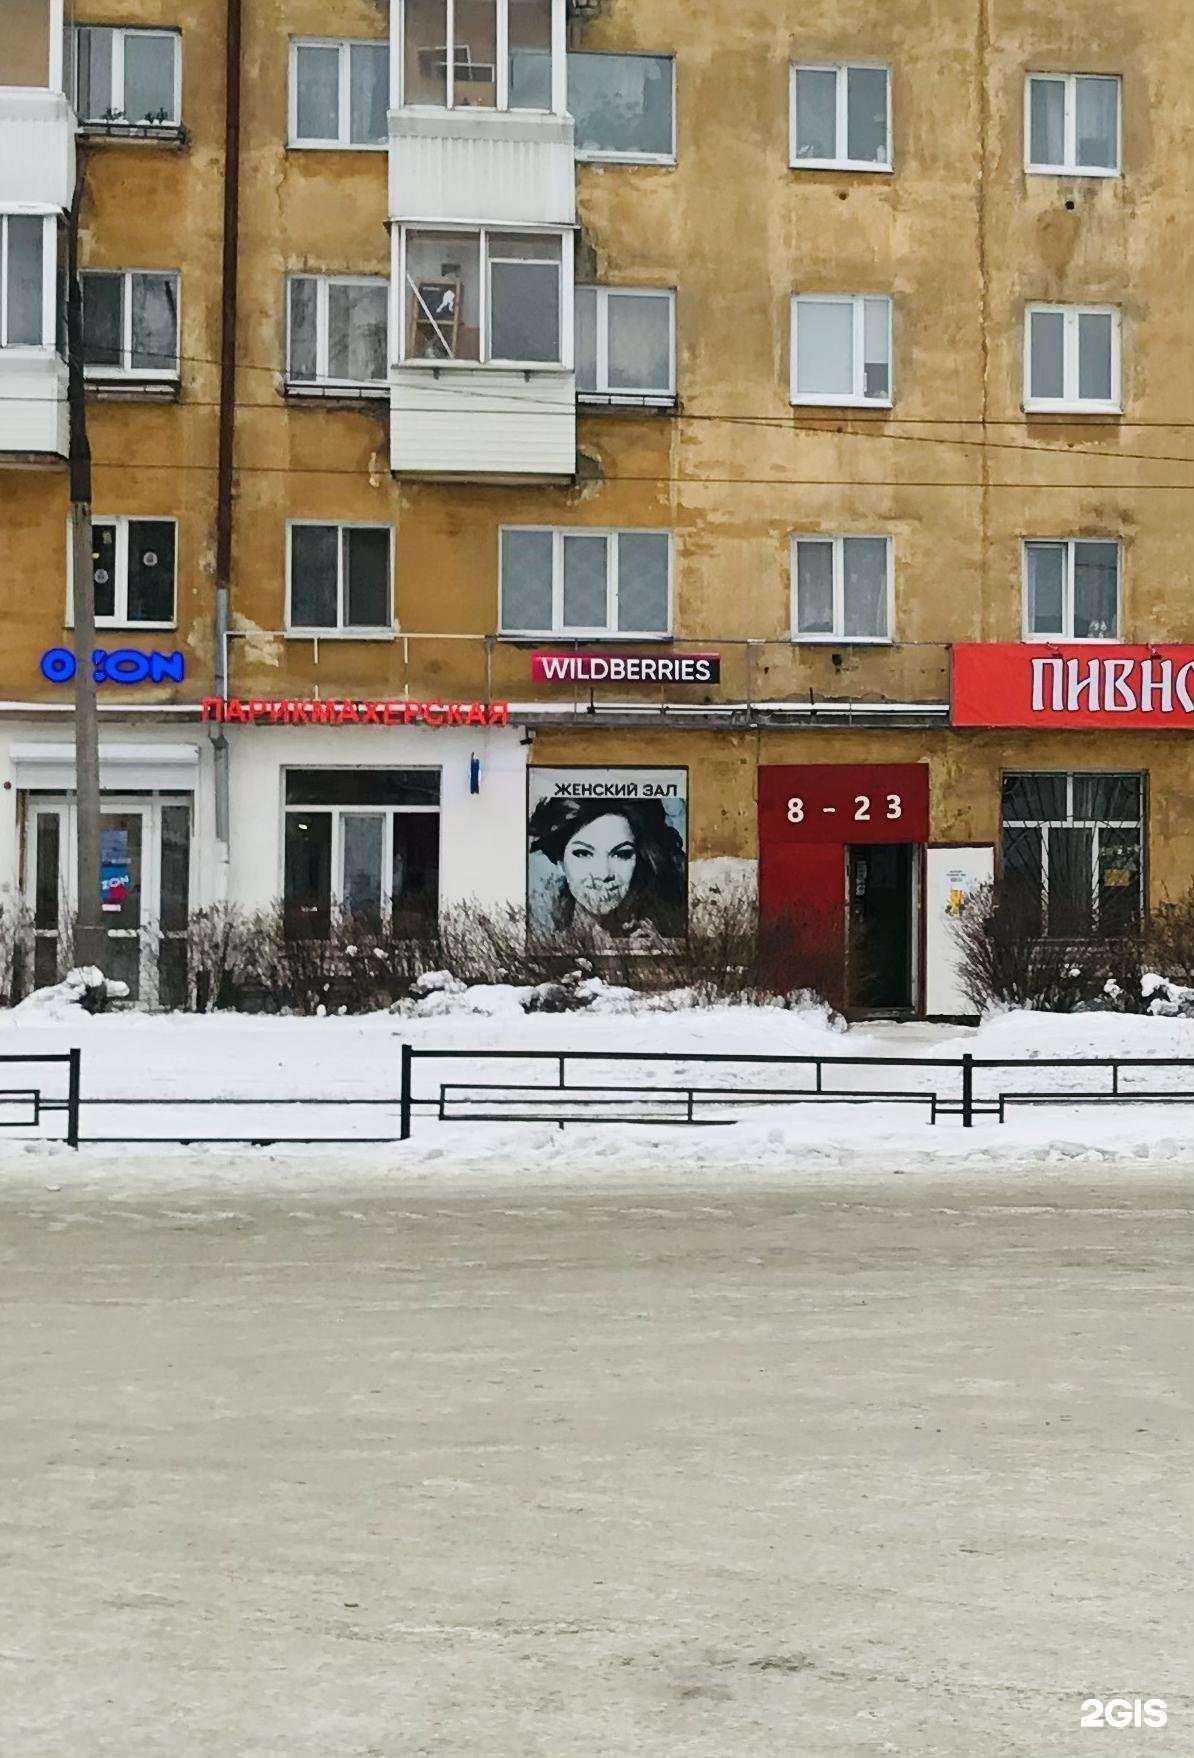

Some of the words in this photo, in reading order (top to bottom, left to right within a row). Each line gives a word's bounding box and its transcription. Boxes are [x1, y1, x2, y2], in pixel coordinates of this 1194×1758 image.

[541, 656, 711, 681] WILDBERRIES
[202, 697, 509, 726] ПАРИКМАХЕРСКАЯ
[554, 782, 638, 797] ЖЕНСКИЙ
[642, 784, 678, 797] ЗАЛ
